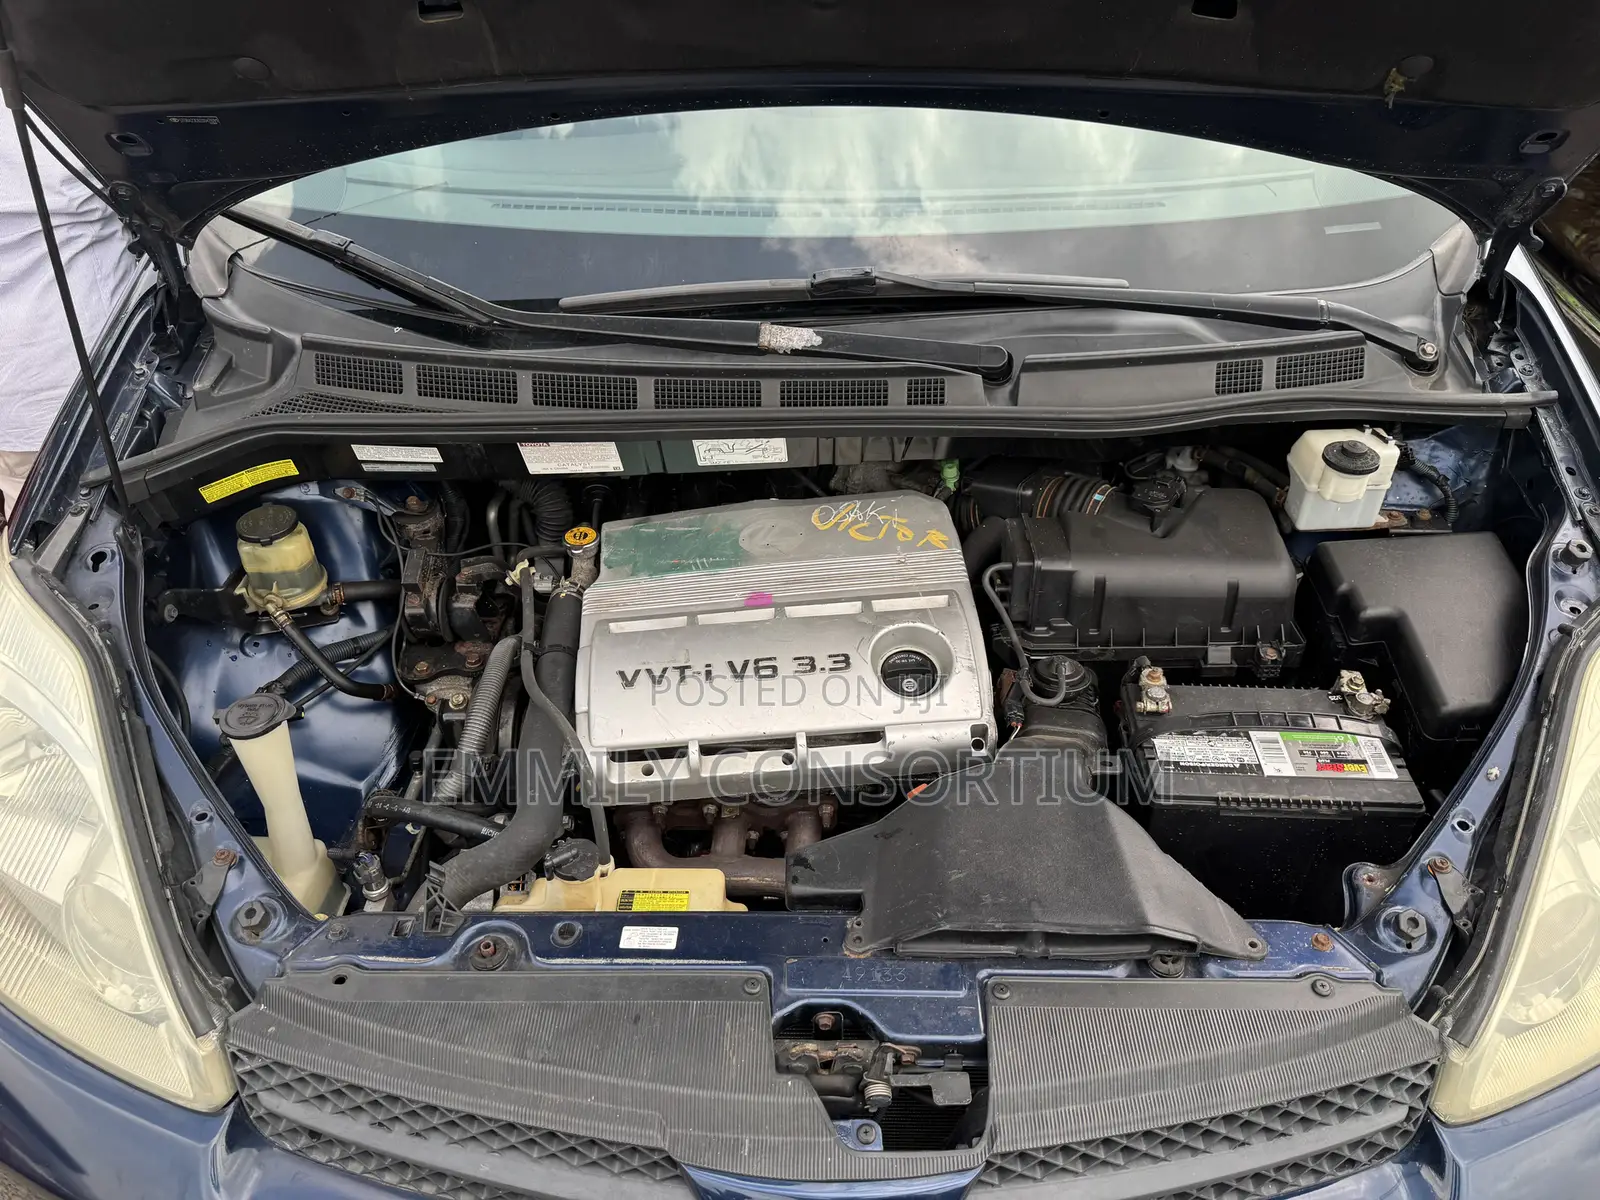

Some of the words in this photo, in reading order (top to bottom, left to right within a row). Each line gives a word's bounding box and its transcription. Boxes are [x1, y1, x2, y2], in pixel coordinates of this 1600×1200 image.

[727, 656, 779, 682] V6
[792, 652, 852, 677] 3.3
[1316, 762, 1369, 774] EverStart
[841, 966, 907, 983] 49133
